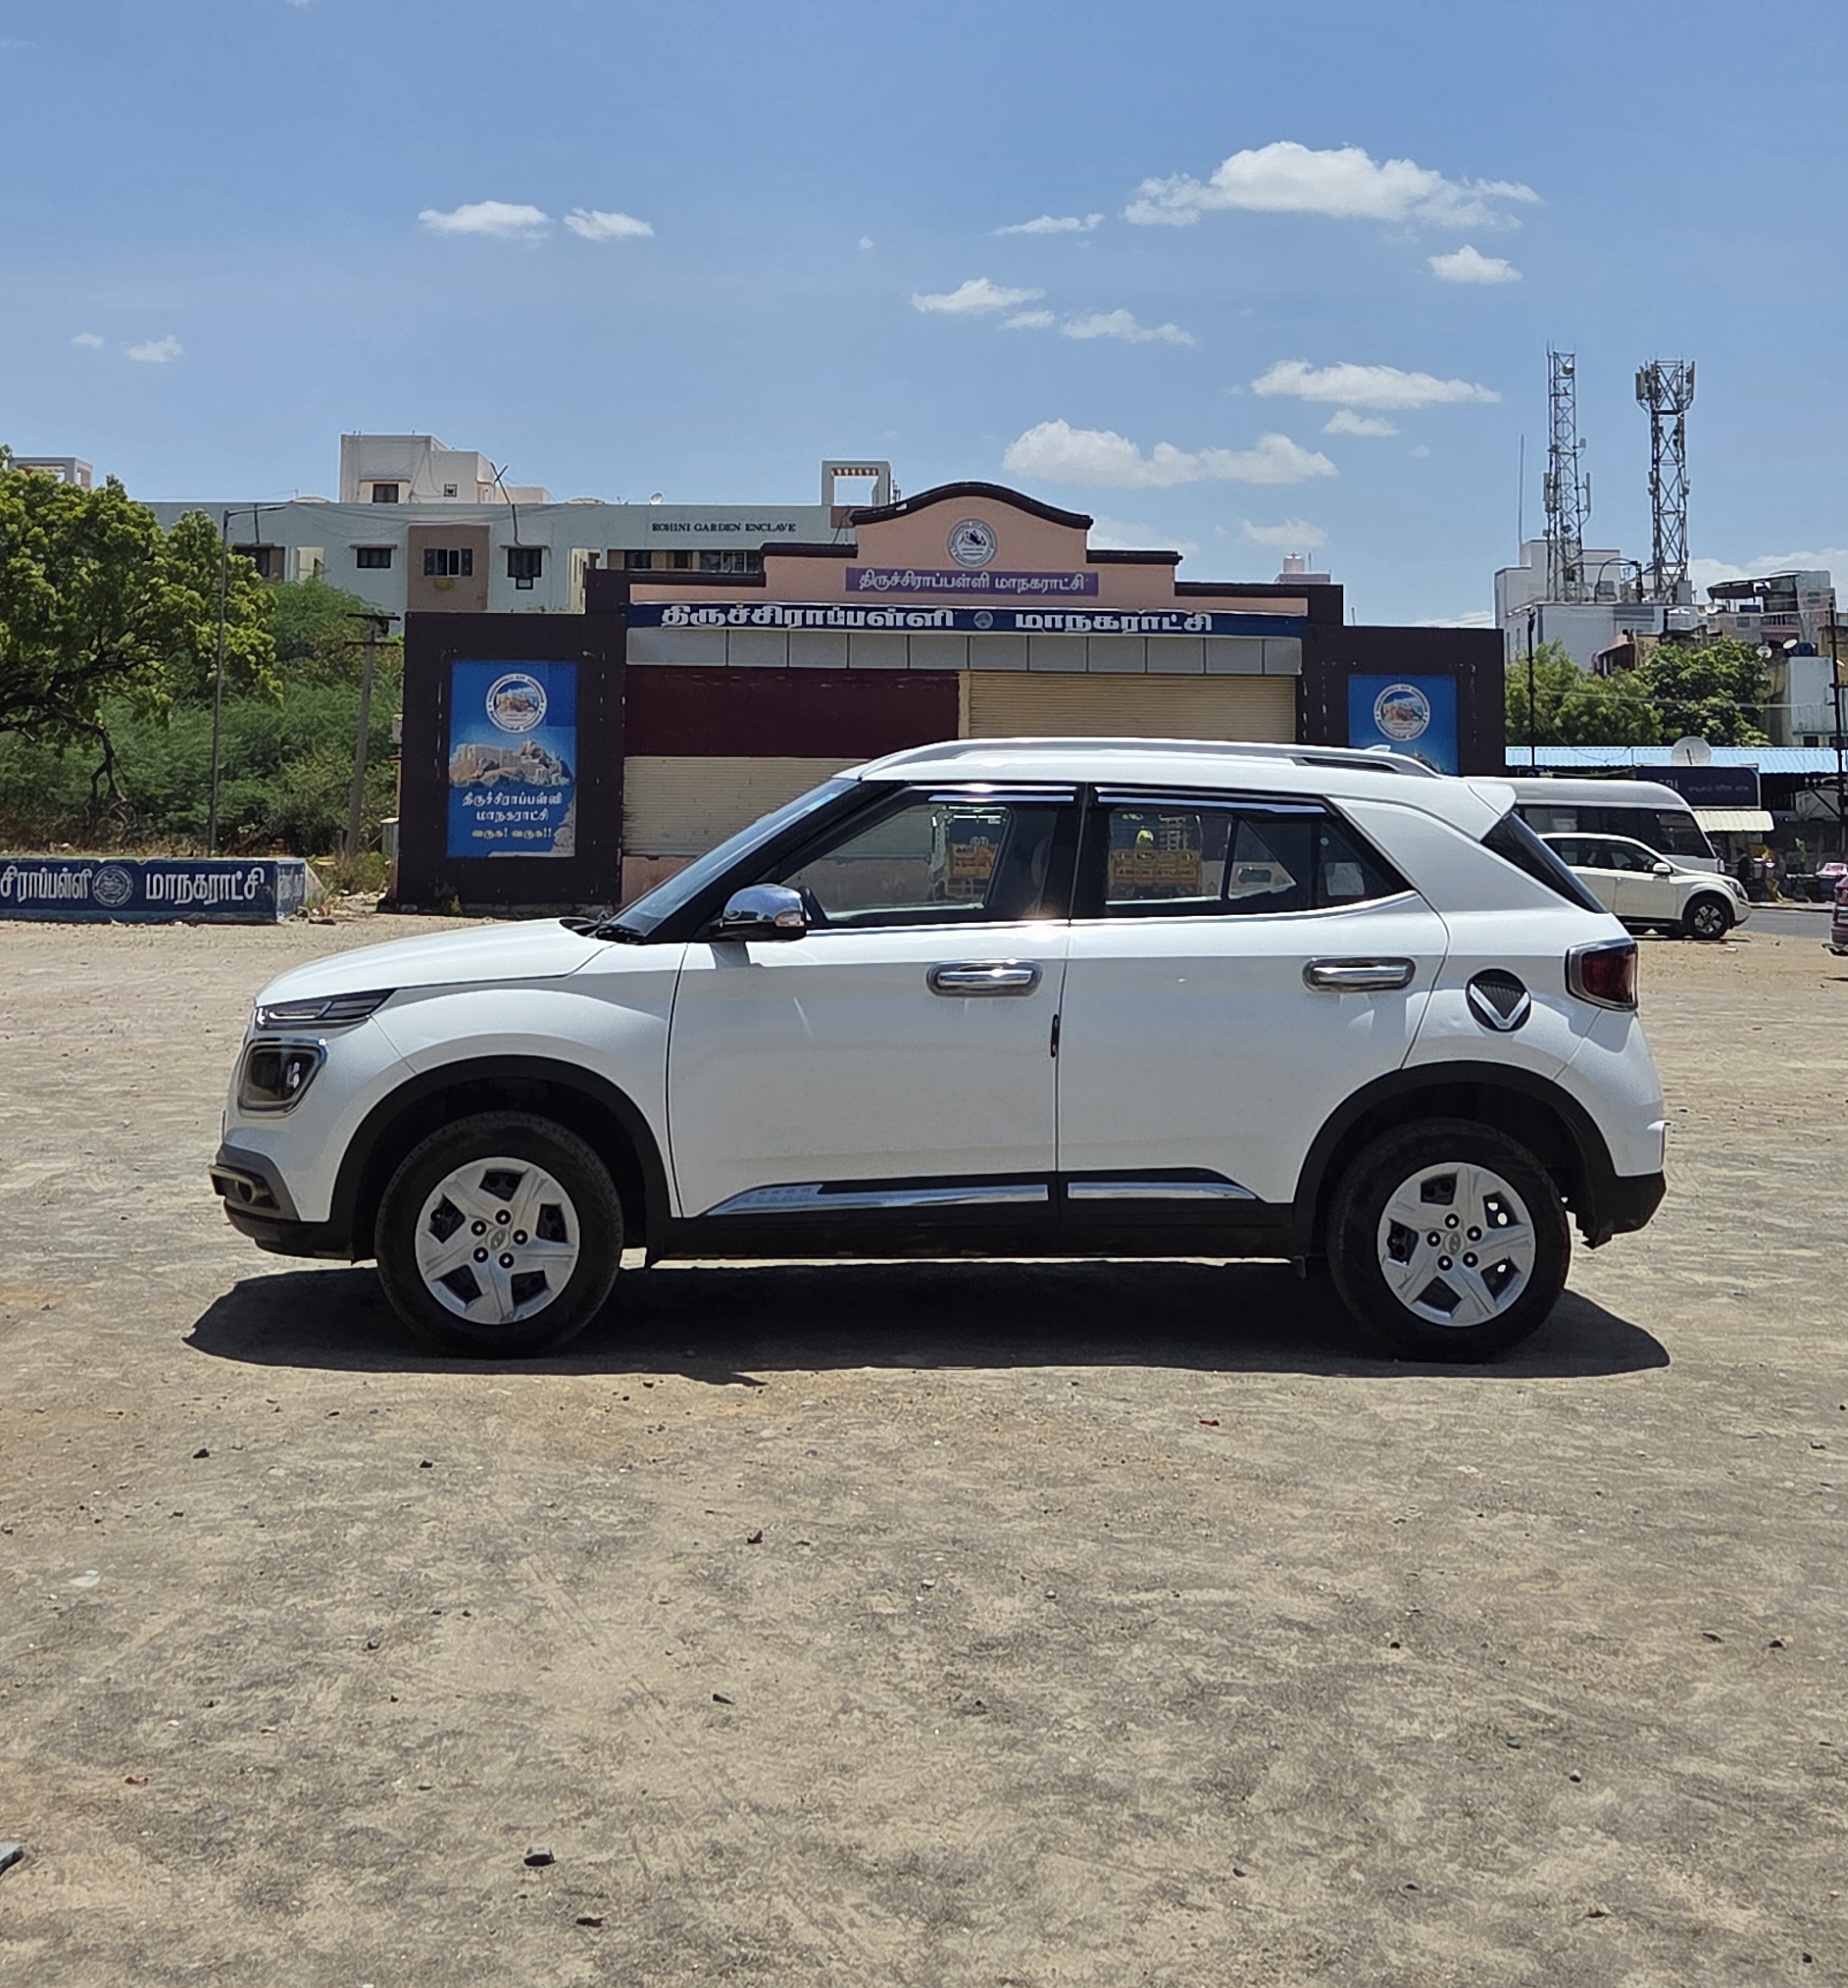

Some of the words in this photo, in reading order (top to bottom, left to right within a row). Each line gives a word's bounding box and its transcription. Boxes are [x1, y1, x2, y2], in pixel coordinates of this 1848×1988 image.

[652, 522, 691, 532] ROHINI
[693, 522, 741, 532] GARDEN
[745, 522, 797, 532] ENCLAVE
[858, 568, 990, 591] திருச்சிராப்பள்ளி
[994, 573, 1085, 594] மாநகராட்சி
[660, 603, 954, 629] திருச்சிராப்பள்ளி
[1015, 612, 1213, 634] மாநகராட்சி
[461, 791, 563, 808] திருச்சிராப்பள்ளி
[476, 807, 549, 824] மாநகராட்சி
[145, 867, 265, 906] மாநகராட்சி
